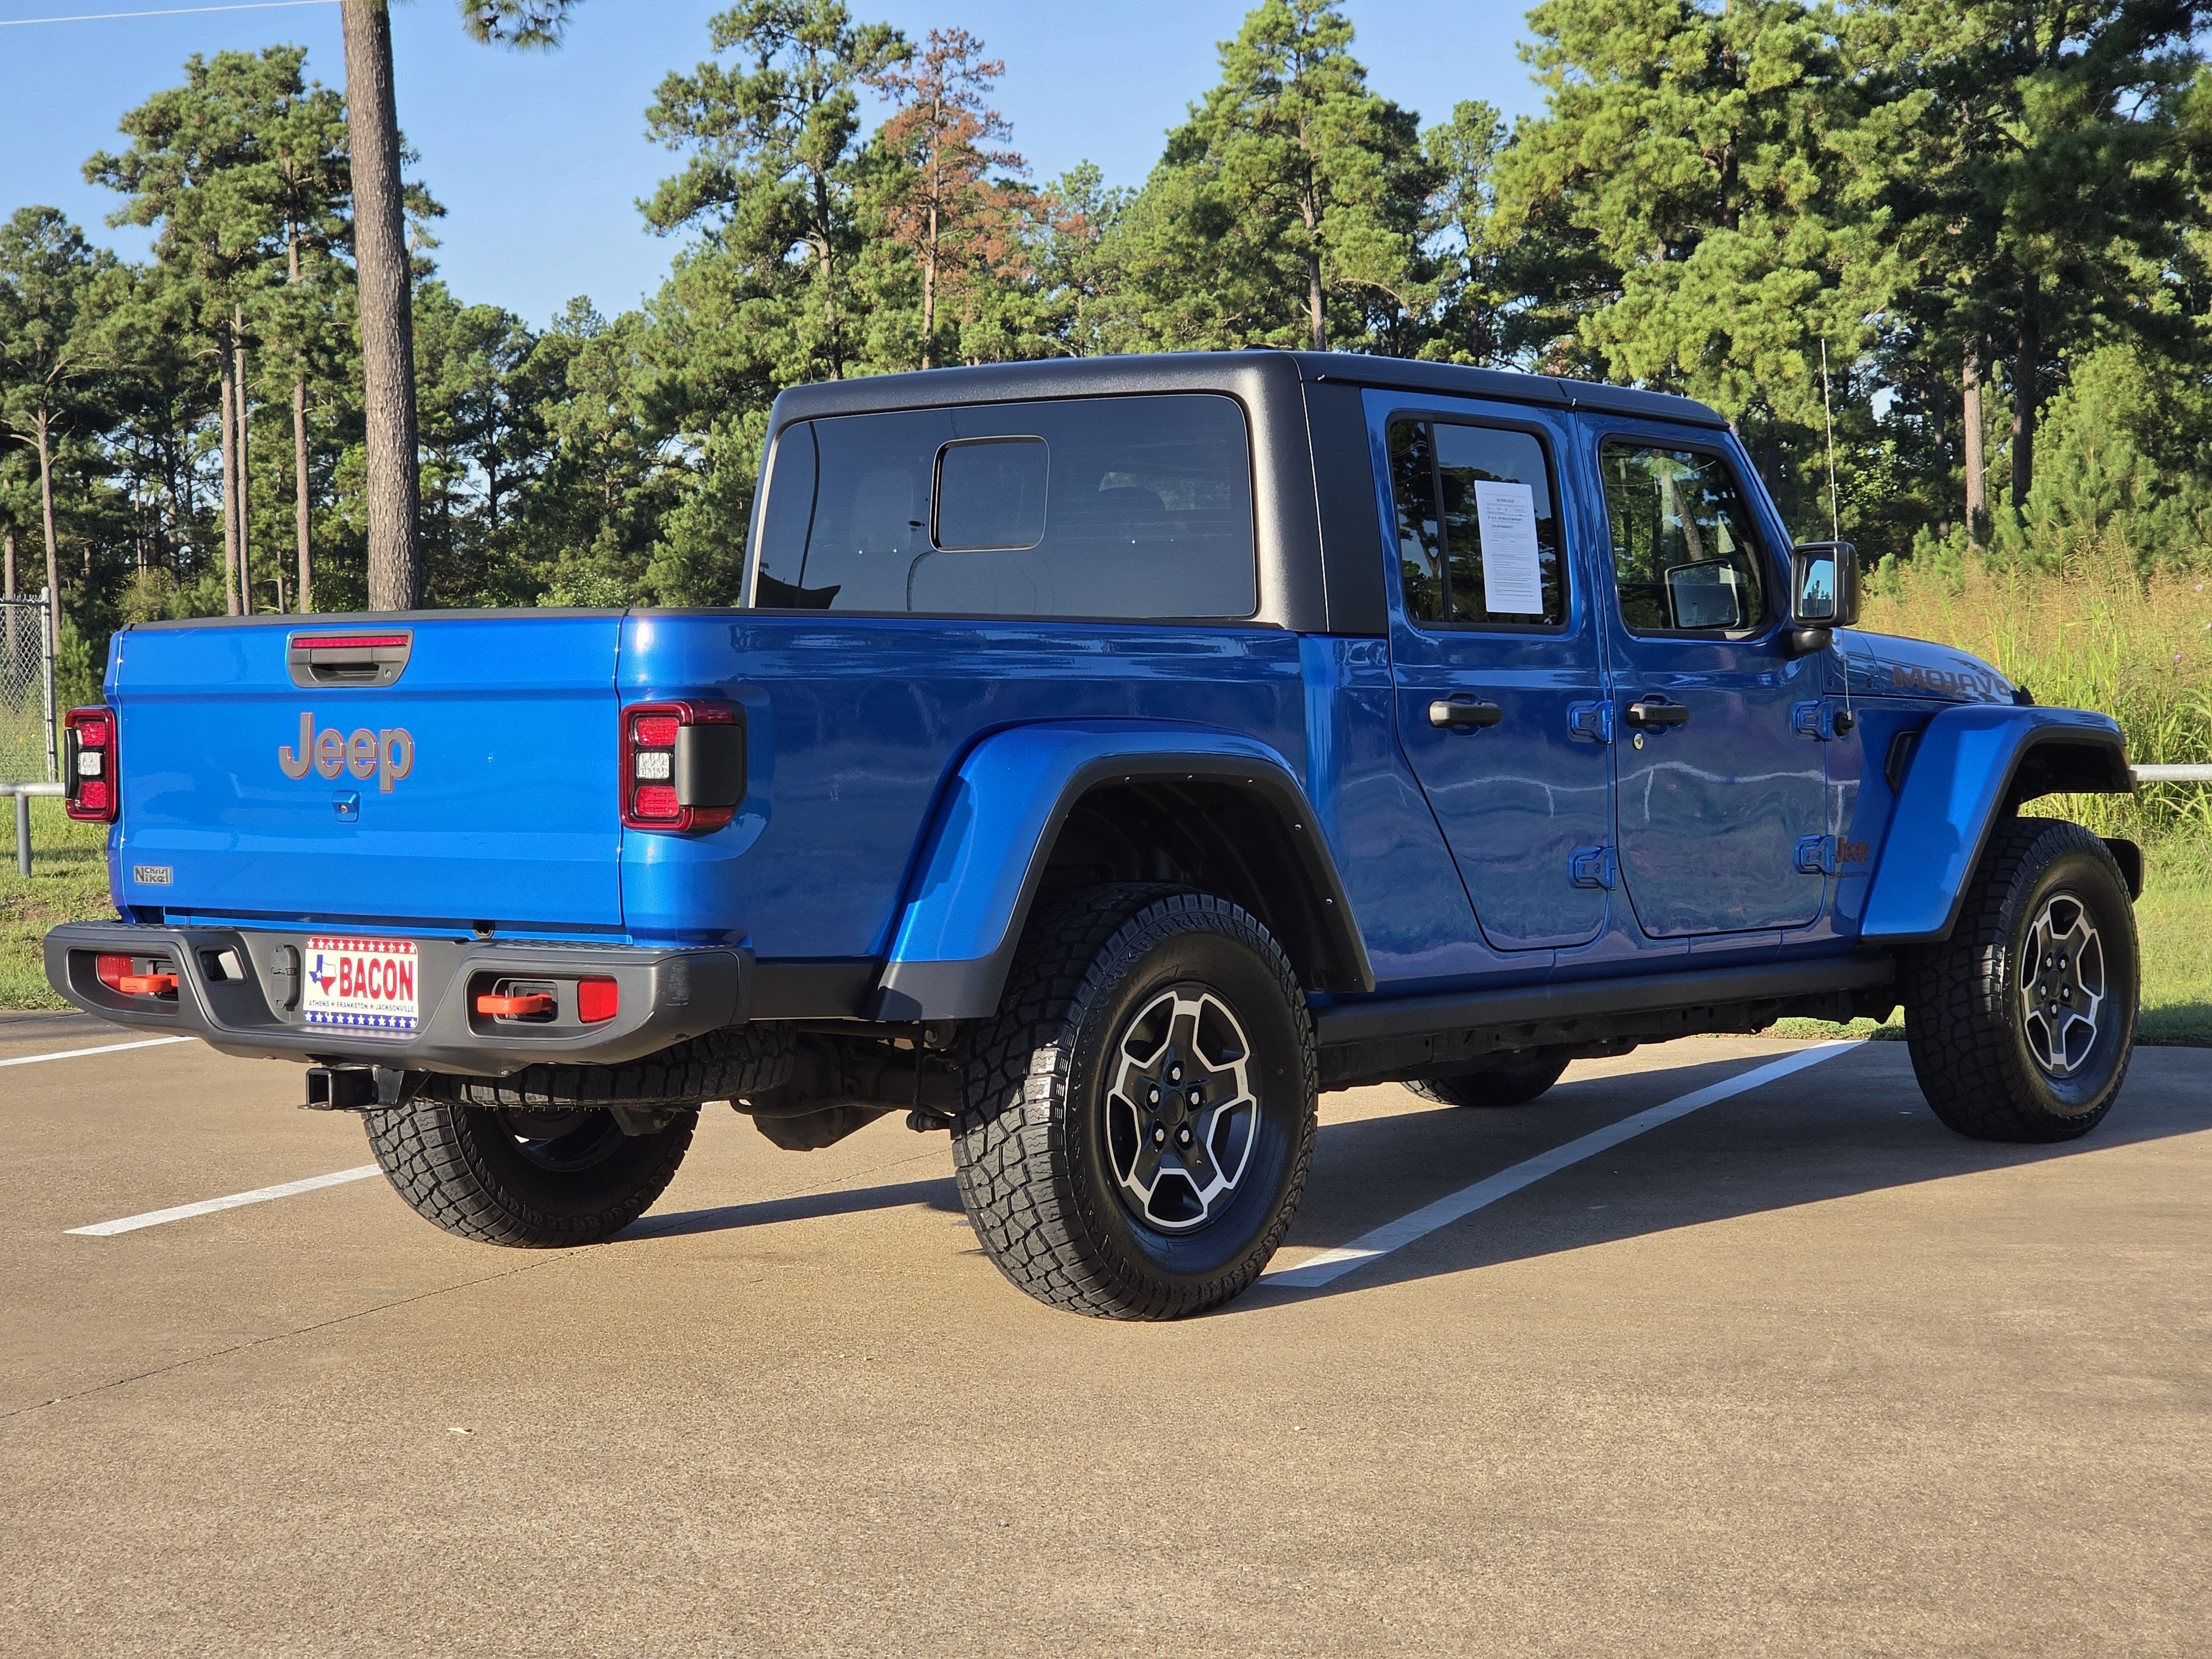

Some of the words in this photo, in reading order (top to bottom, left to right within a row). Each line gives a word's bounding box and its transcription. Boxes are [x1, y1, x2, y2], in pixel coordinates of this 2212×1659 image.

[1892, 665, 2012, 697] MOJAVE
[279, 712, 414, 793] Jeep
[1835, 837, 1869, 865] Jeep
[135, 867, 169, 883] Nikel
[340, 957, 414, 1001] BACON
[337, 1001, 368, 1010] FRANKSTON
[376, 1004, 414, 1013] JACKSONVILLE
